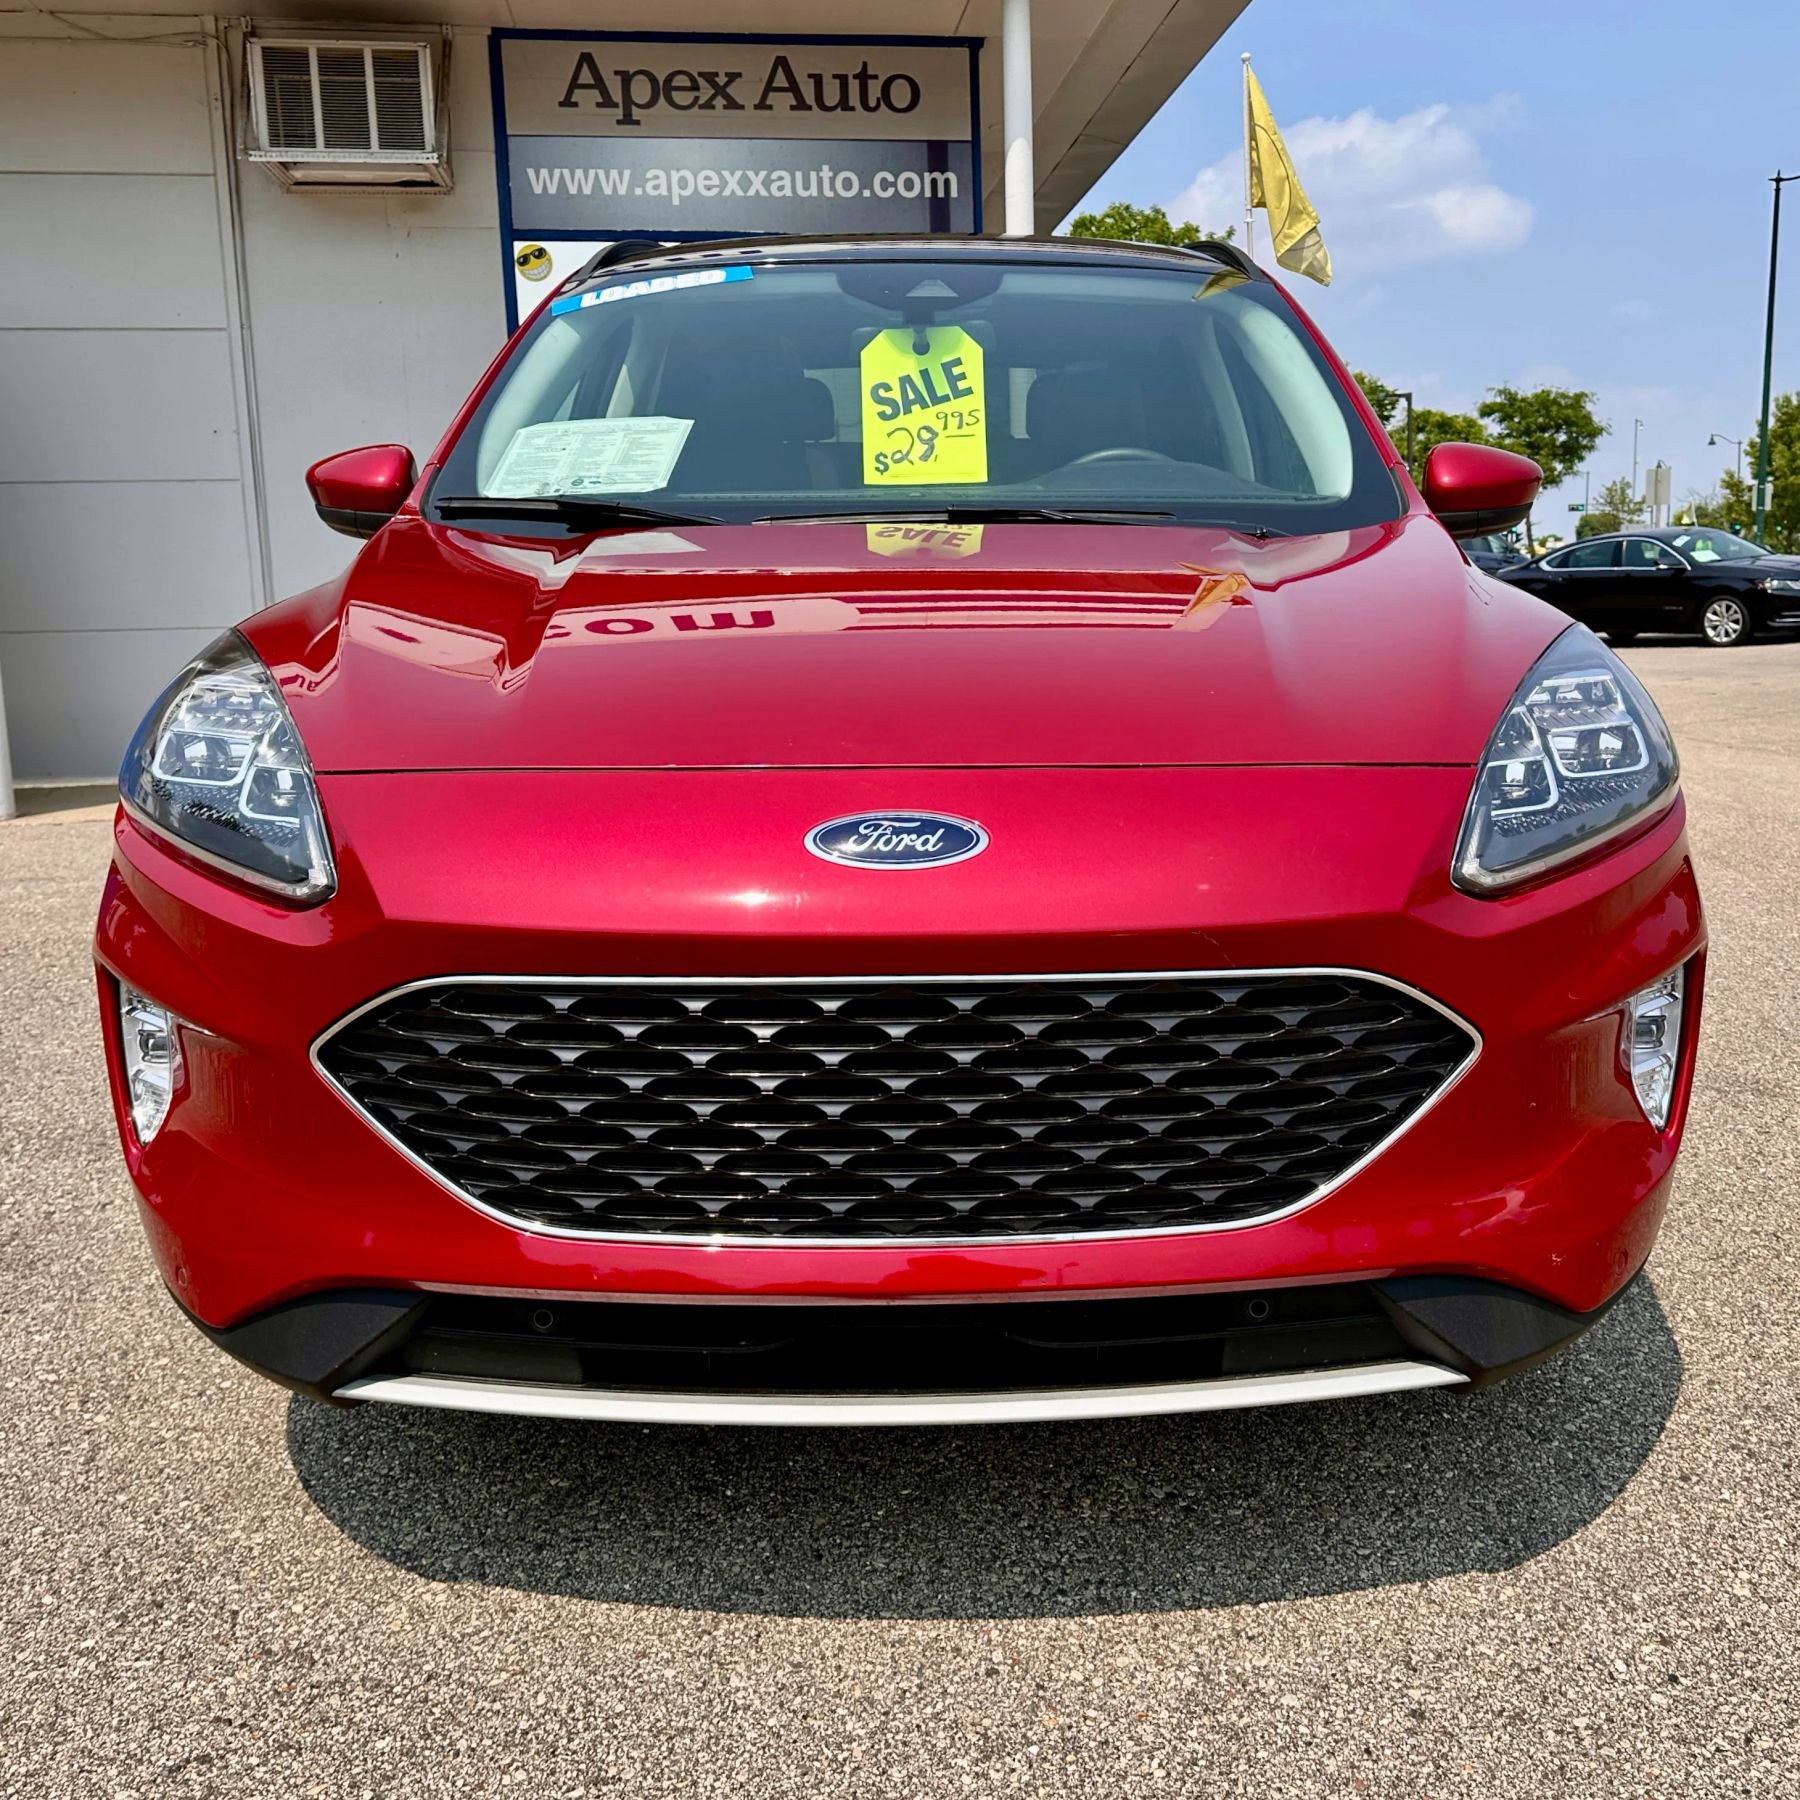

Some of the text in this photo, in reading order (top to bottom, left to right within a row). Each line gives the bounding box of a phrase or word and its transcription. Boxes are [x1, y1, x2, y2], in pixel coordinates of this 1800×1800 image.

[558, 51, 921, 126] Apex Auto
[526, 164, 959, 205] www.apexxauto.com
[580, 268, 727, 308] LOADED
[870, 357, 974, 422] SALE
[848, 820, 945, 852] Ford
